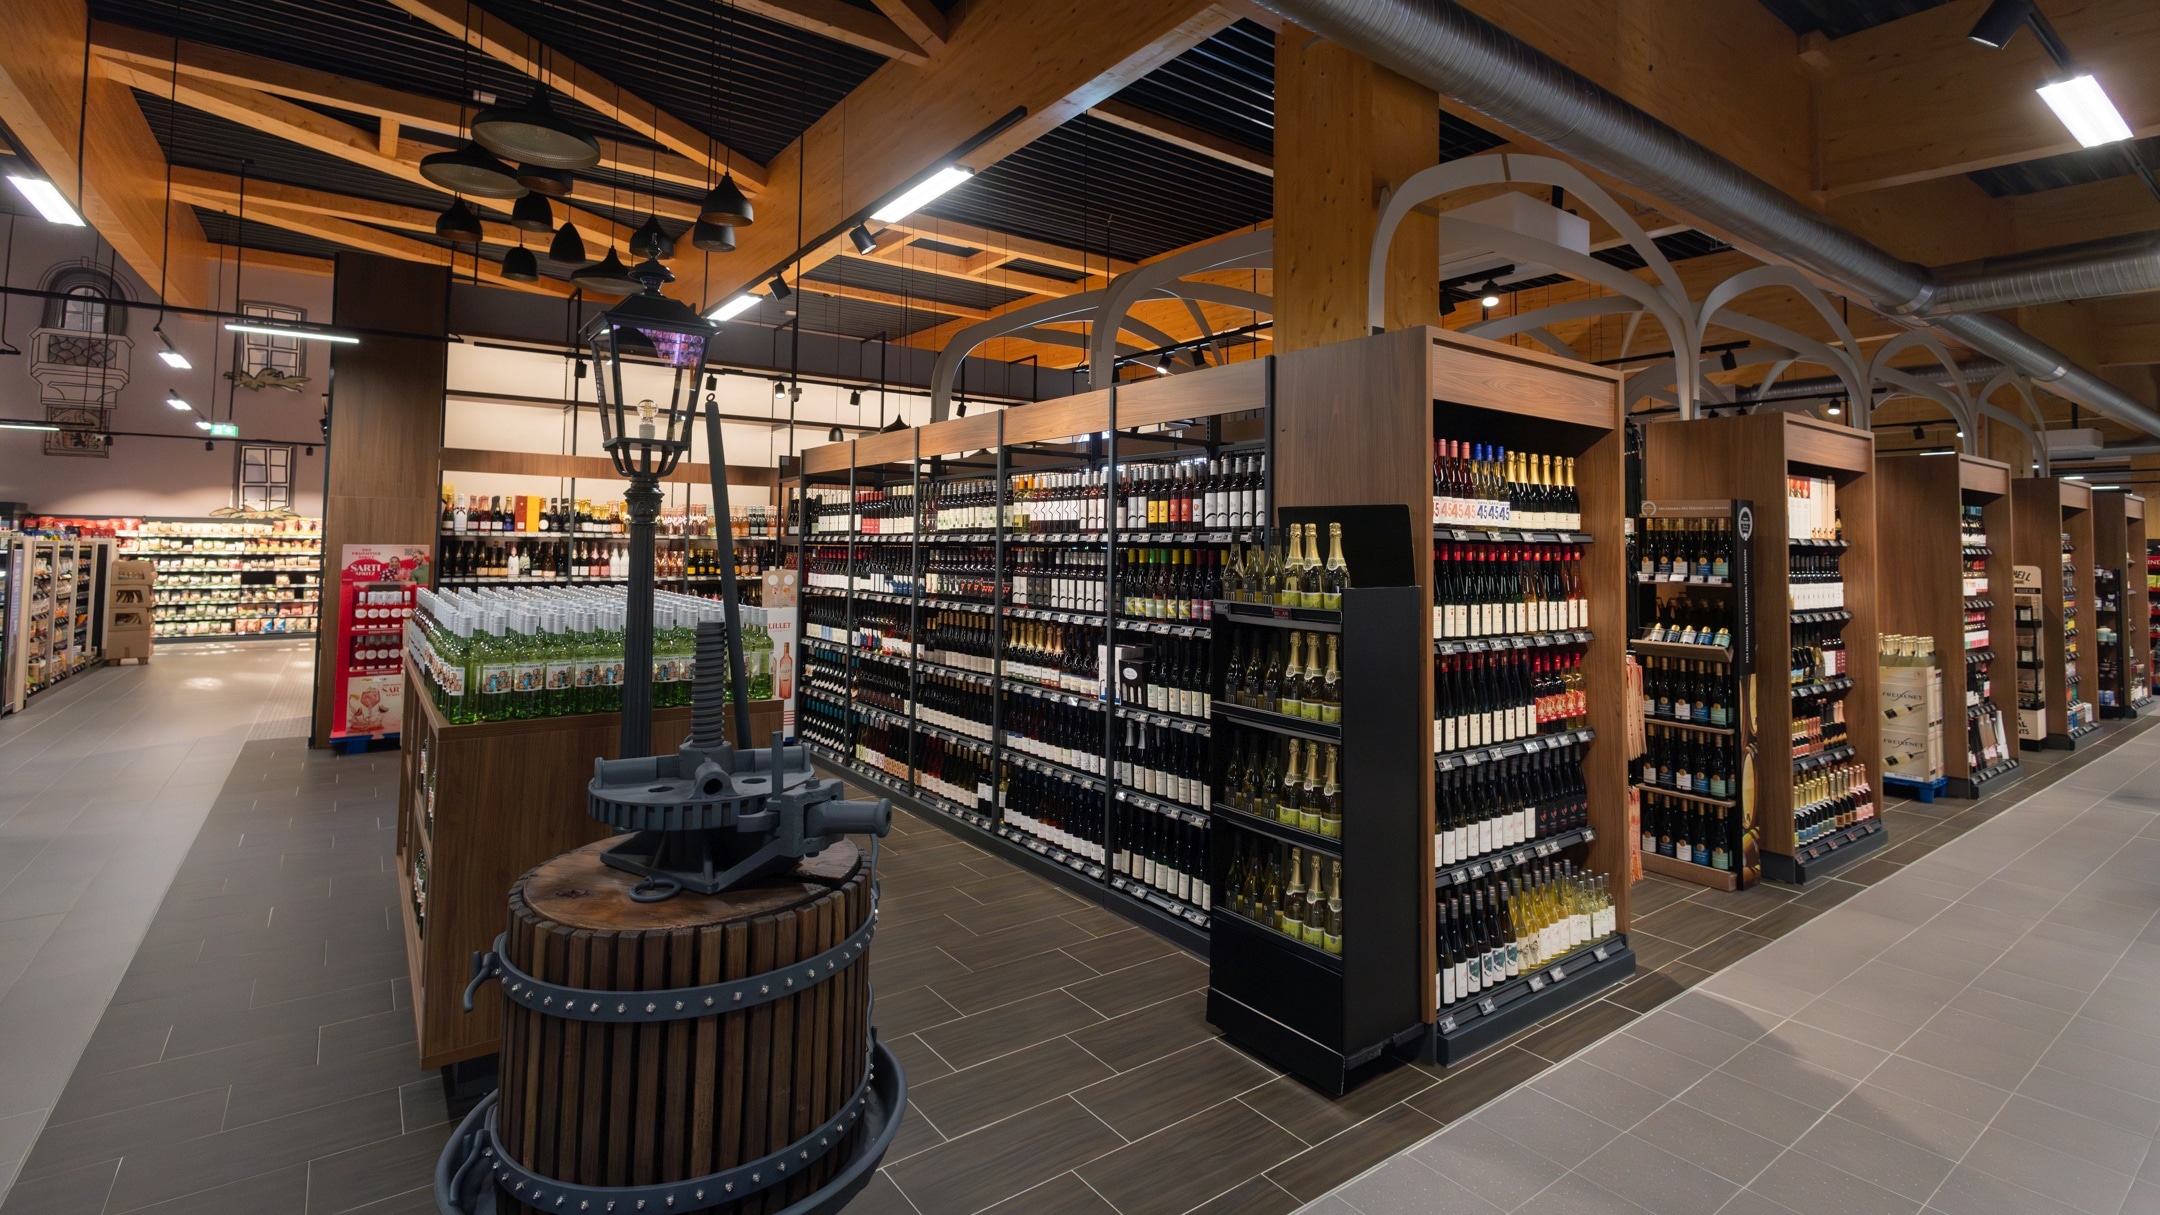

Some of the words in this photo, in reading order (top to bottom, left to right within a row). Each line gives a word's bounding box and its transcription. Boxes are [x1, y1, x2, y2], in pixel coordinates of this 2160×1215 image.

[1441, 502, 1452, 517] 45
[1452, 504, 1464, 518] 45
[1464, 504, 1476, 519] 45
[1477, 504, 1488, 520] 45
[1488, 506, 1499, 520] 45
[1500, 506, 1510, 520] 45
[350, 564, 380, 572] SARTI
[1882, 690, 1922, 701] FREIXENET
[1883, 738, 1924, 748] FREIXENET
